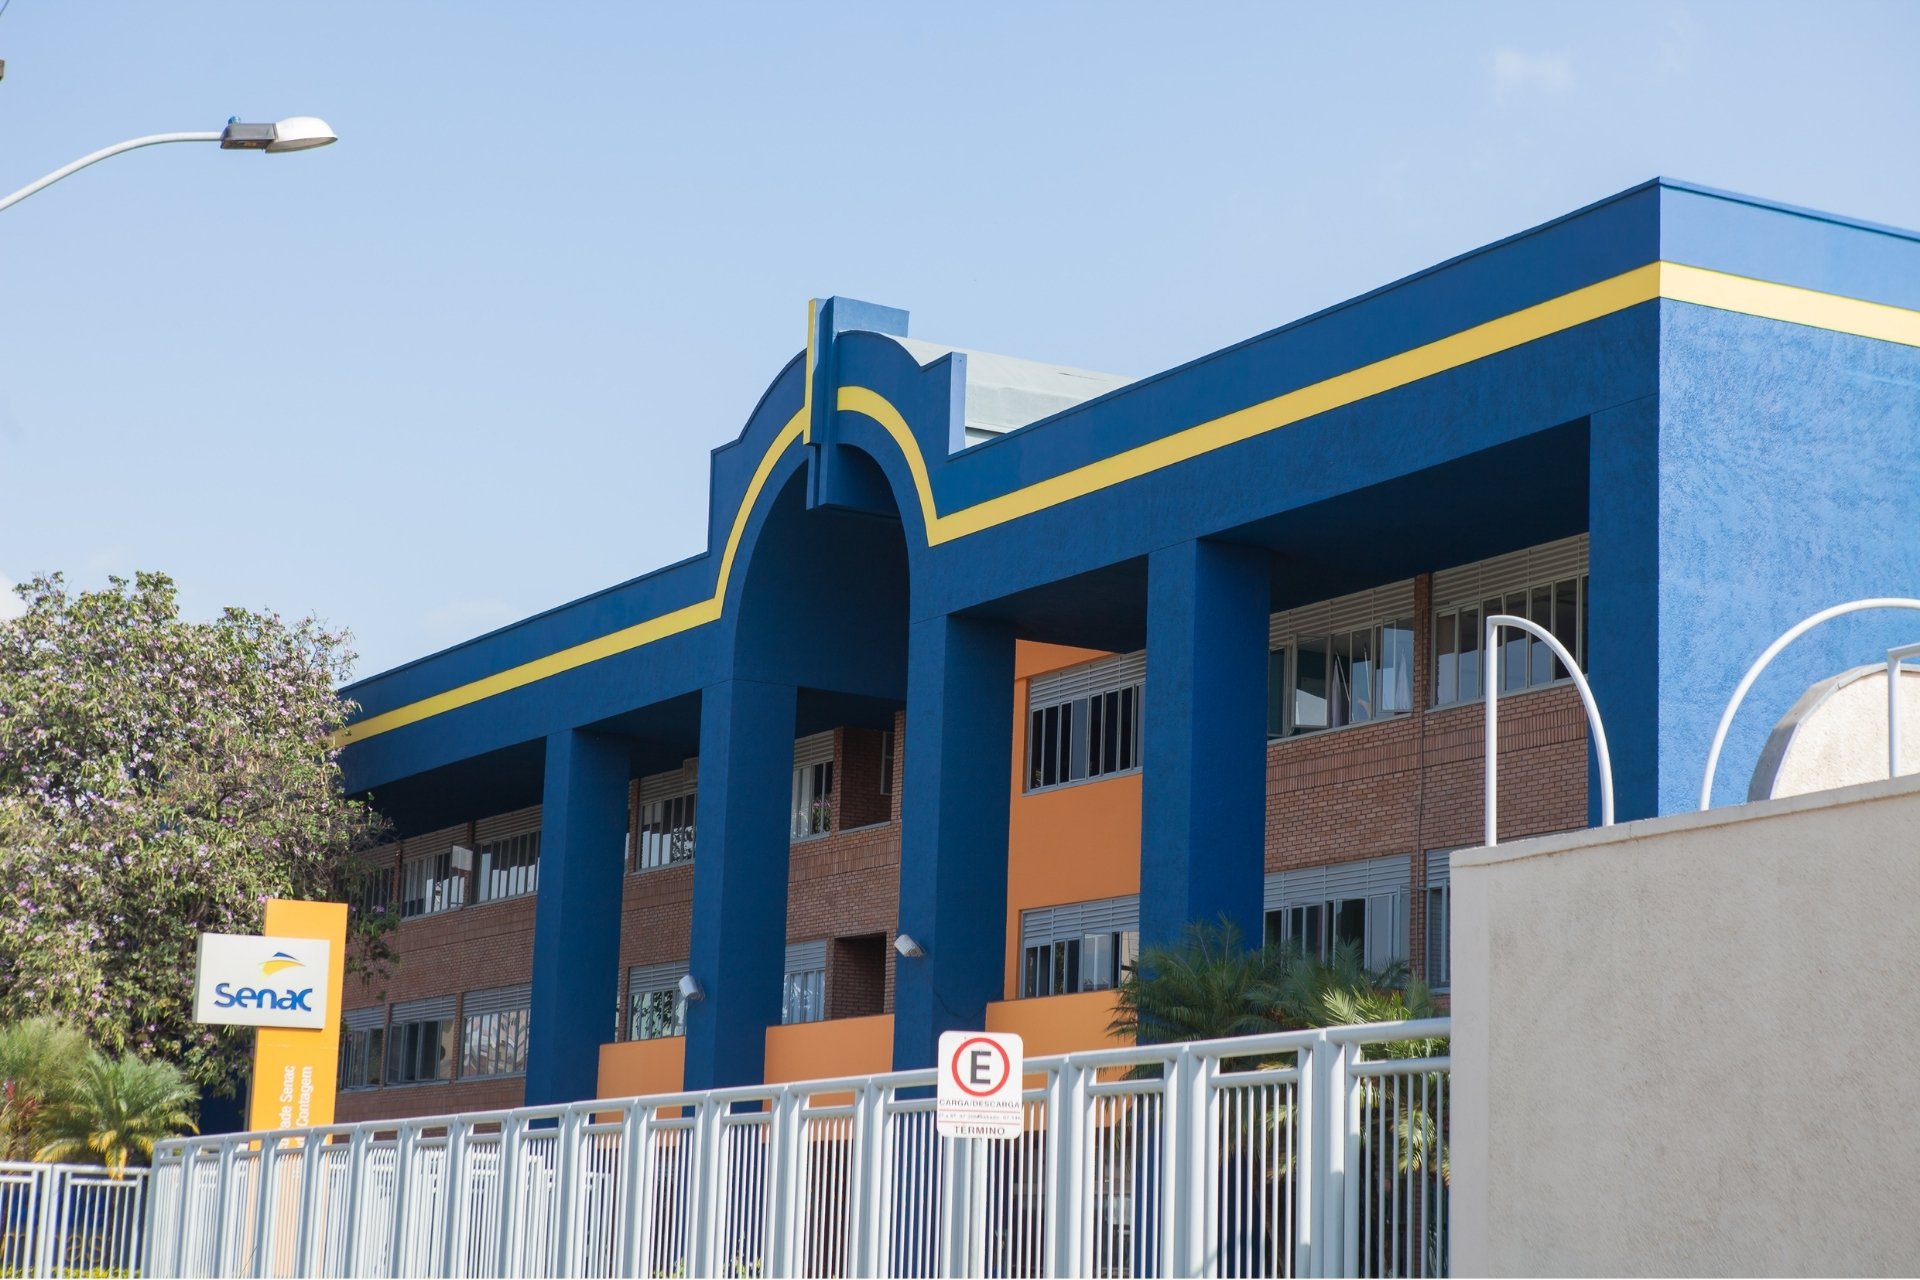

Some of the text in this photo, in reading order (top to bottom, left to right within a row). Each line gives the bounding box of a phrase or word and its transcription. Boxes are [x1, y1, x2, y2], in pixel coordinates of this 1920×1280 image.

[214, 982, 313, 1012] Senac
[280, 1065, 295, 1103] Senac
[970, 1050, 991, 1085] E
[296, 1066, 314, 1128] Contagem
